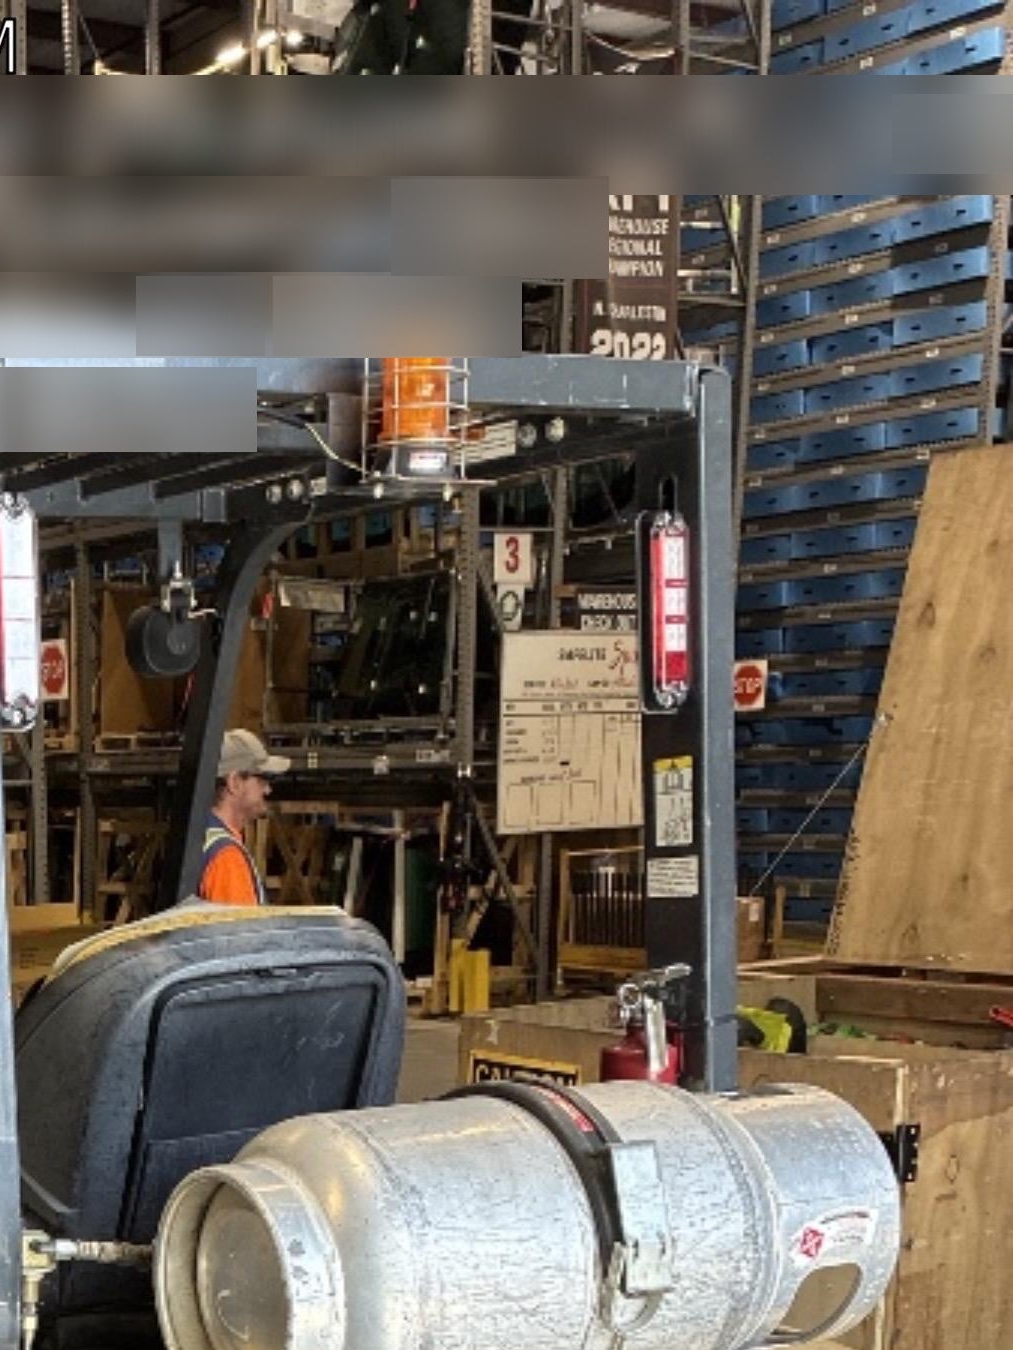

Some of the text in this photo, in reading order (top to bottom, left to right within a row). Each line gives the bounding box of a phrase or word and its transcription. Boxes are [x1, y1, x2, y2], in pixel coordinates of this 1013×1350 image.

[589, 328, 667, 361] 2022
[505, 536, 520, 573] 3
[578, 593, 637, 610] WAREHOUS
[734, 678, 760, 694] STOP
